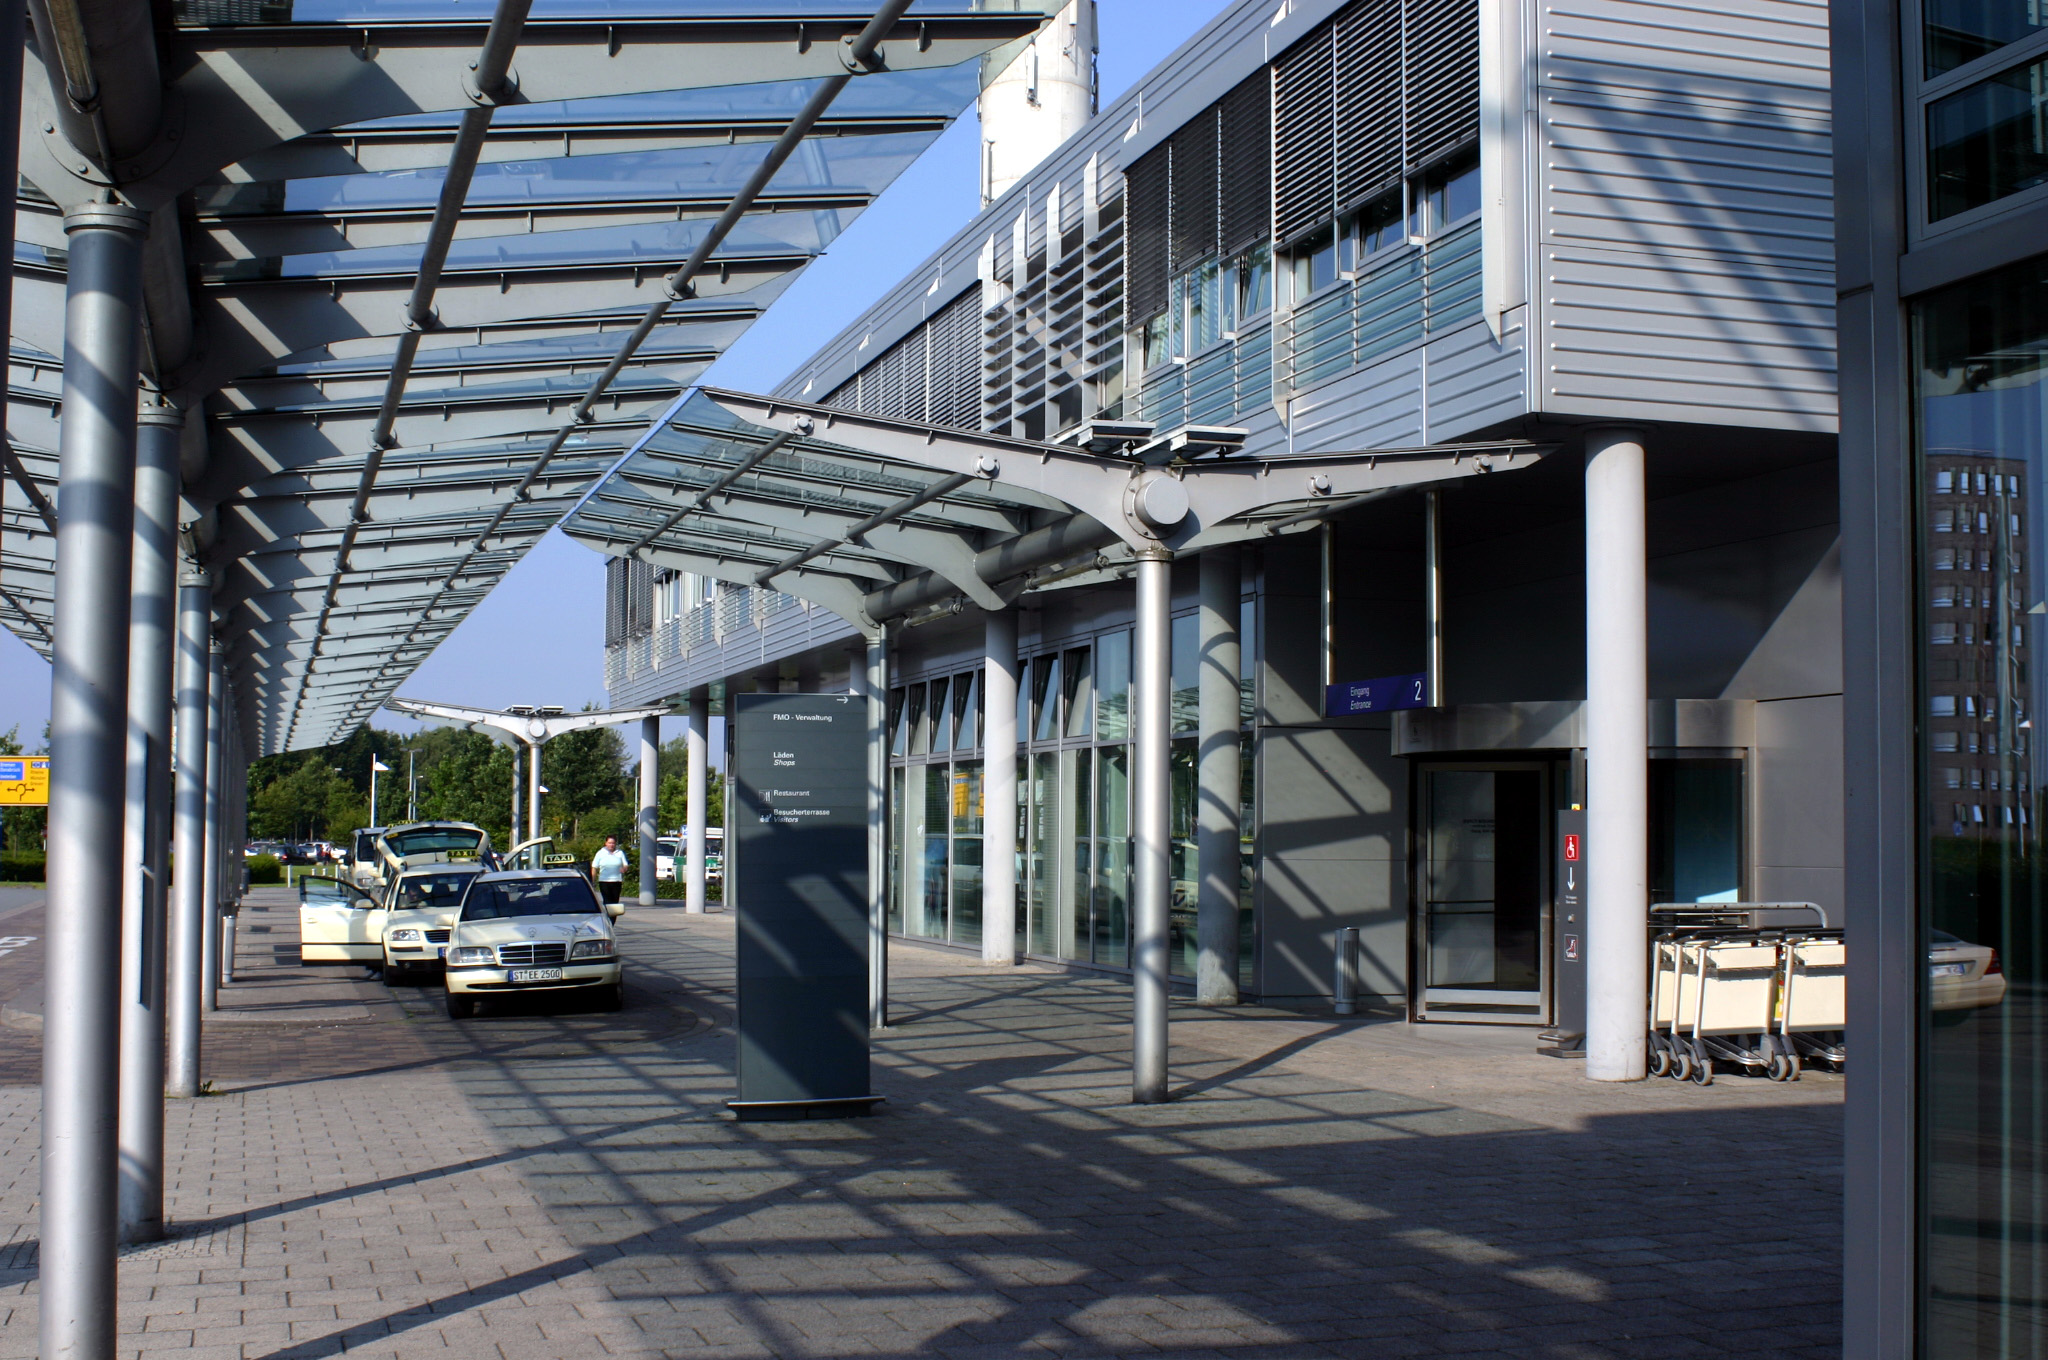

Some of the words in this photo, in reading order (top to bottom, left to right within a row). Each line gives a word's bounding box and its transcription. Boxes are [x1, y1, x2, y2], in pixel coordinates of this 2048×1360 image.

[1350, 686, 1370, 698] Eingang
[1414, 680, 1422, 701] 2
[1350, 700, 1372, 710] Entrance
[773, 713, 790, 721] FMO
[795, 714, 833, 722] Verwaltung
[773, 751, 795, 759] Läden
[773, 759, 796, 767] Shops
[773, 789, 810, 797] Restaurant
[549, 854, 572, 862] TAXI
[513, 971, 524, 980] ST
[528, 970, 539, 979] EE
[540, 969, 560, 979] 2500
